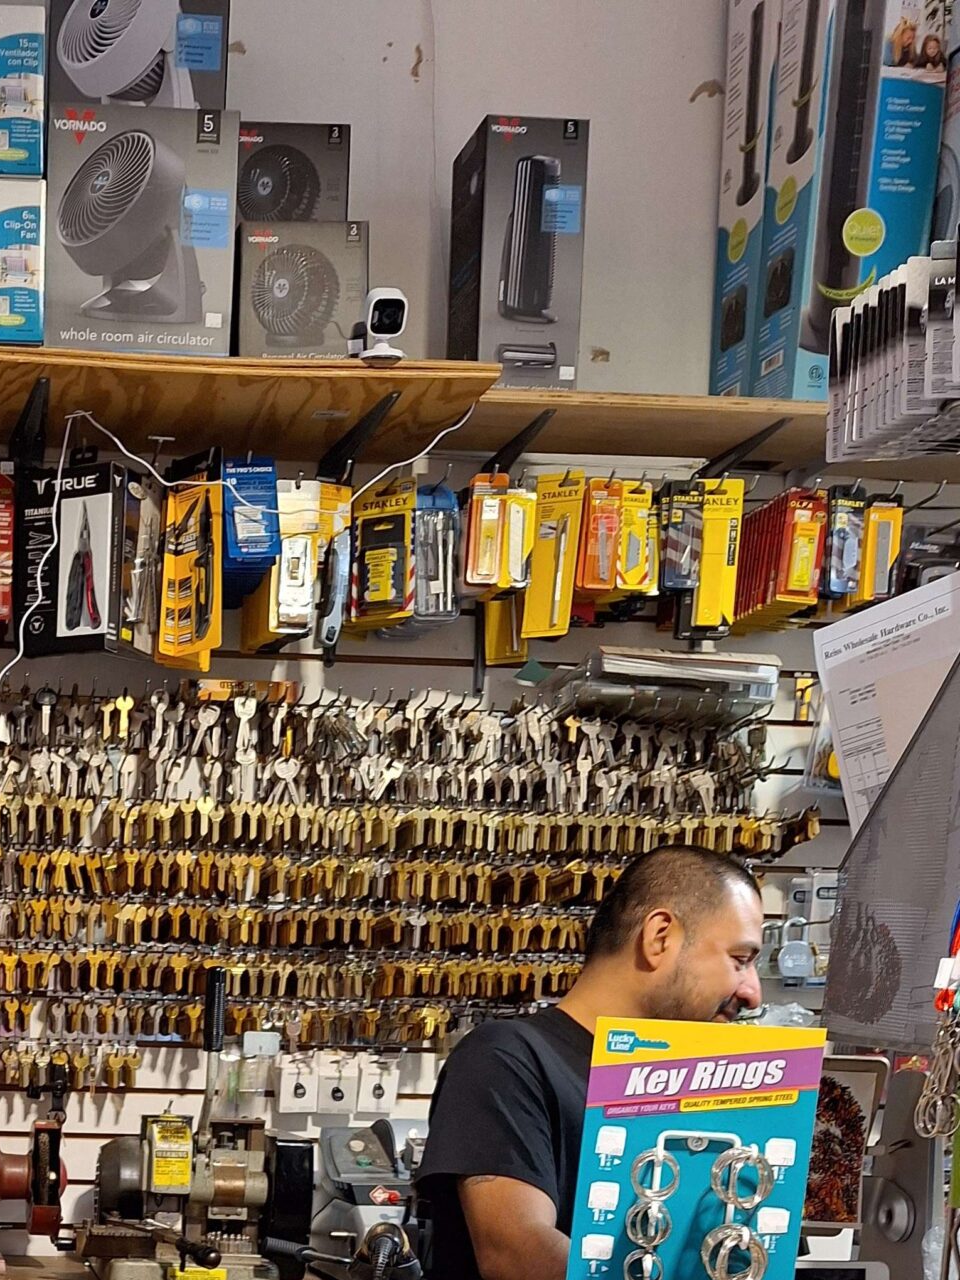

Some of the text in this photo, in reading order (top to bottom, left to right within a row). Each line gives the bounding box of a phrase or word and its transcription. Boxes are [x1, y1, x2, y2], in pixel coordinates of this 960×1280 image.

[53, 118, 107, 133] VORNADO
[203, 115, 215, 133] 5
[4, 220, 37, 231] Clip-On
[20, 230, 37, 239] Fan
[60, 329, 215, 346] whole room air circulator
[52, 474, 98, 491] TRUE
[542, 489, 580, 502] STANLEY
[672, 495, 704, 503] STANLEY
[361, 496, 410, 511] STANLEY
[837, 499, 865, 507] STANLEY
[880, 617, 917, 638] Hardware
[608, 1033, 634, 1044] Lucky
[611, 1041, 631, 1051] Line
[624, 1058, 787, 1096] Key Rings
[683, 1093, 794, 1109] QUALITY TEMPERED SPRING STEEL
[606, 1103, 676, 1114] ORGANIZE YOUR KEYS
